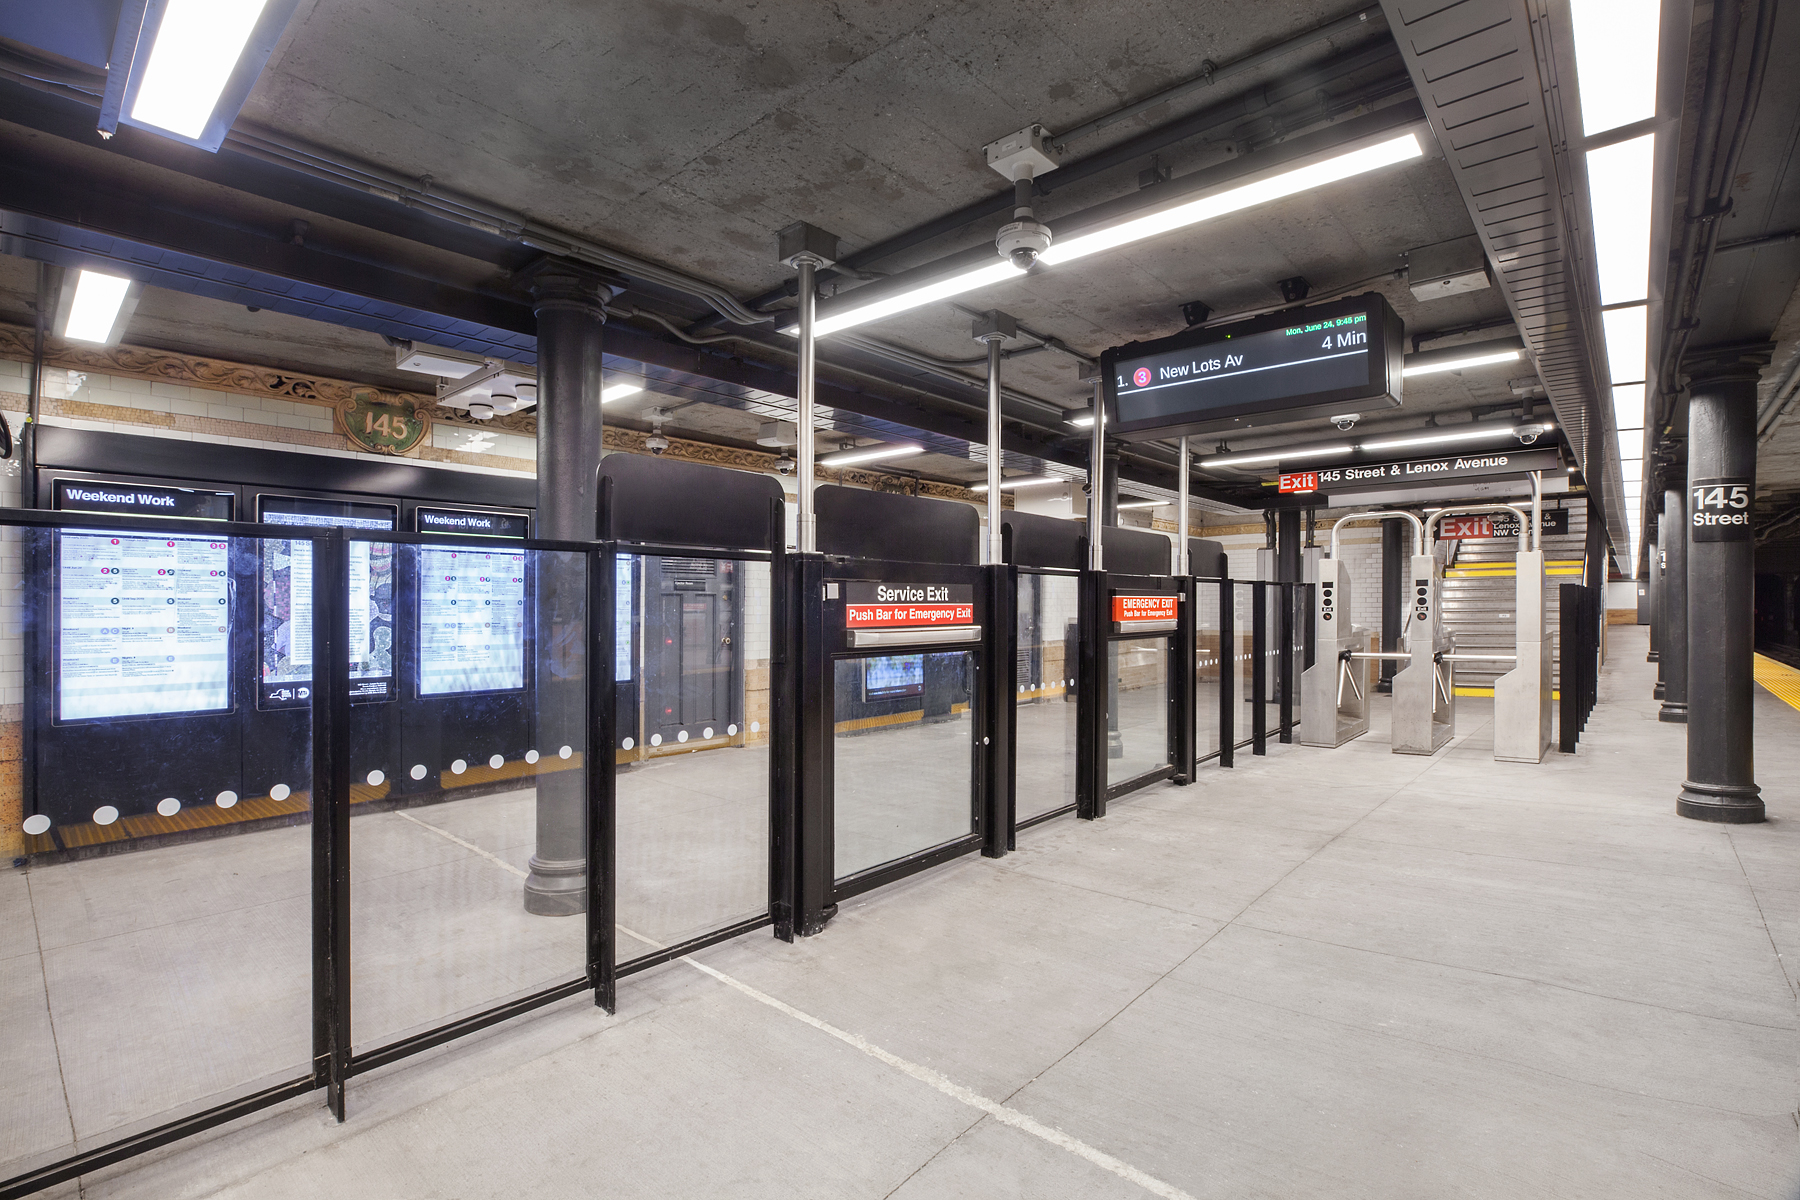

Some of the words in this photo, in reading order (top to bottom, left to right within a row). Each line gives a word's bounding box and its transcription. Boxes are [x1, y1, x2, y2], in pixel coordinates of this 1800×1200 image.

[1304, 324, 1322, 333] June
[1323, 320, 1335, 329] 24,
[1336, 317, 1353, 326] 9:45
[1354, 315, 1367, 324] pm
[1117, 375, 1128, 387] 1.
[1137, 371, 1147, 383] 3
[1160, 365, 1189, 379] New
[1192, 358, 1221, 374] Lots
[1224, 354, 1243, 368] Av
[1321, 335, 1333, 349] 4
[1337, 331, 1367, 347] Min
[366, 411, 407, 439] 145
[1280, 474, 1314, 489] Exit
[1318, 471, 1341, 482] 145
[1345, 467, 1386, 480] Street
[1390, 465, 1401, 476] &
[1406, 462, 1449, 474] Lenox
[1454, 456, 1508, 470] Avenue
[66, 488, 135, 504] Weekend
[137, 493, 175, 507] Work
[1693, 487, 1749, 510] 145
[424, 514, 466, 526] Weekend
[467, 517, 491, 528] Work
[1493, 522, 1520, 530] Lenox
[1693, 511, 1749, 526] Street
[1440, 517, 1490, 537] Exit
[1493, 529, 1510, 537] NW
[877, 585, 924, 601] Service
[926, 586, 949, 601] Exit
[1123, 598, 1160, 609] EMERGENCY
[1161, 599, 1174, 608] EXIT
[849, 609, 874, 621] Push
[876, 609, 893, 620] Bar
[894, 608, 907, 619] for
[909, 607, 954, 621] Emergency
[956, 607, 971, 618] Exit
[1147, 609, 1165, 617] Emergency
